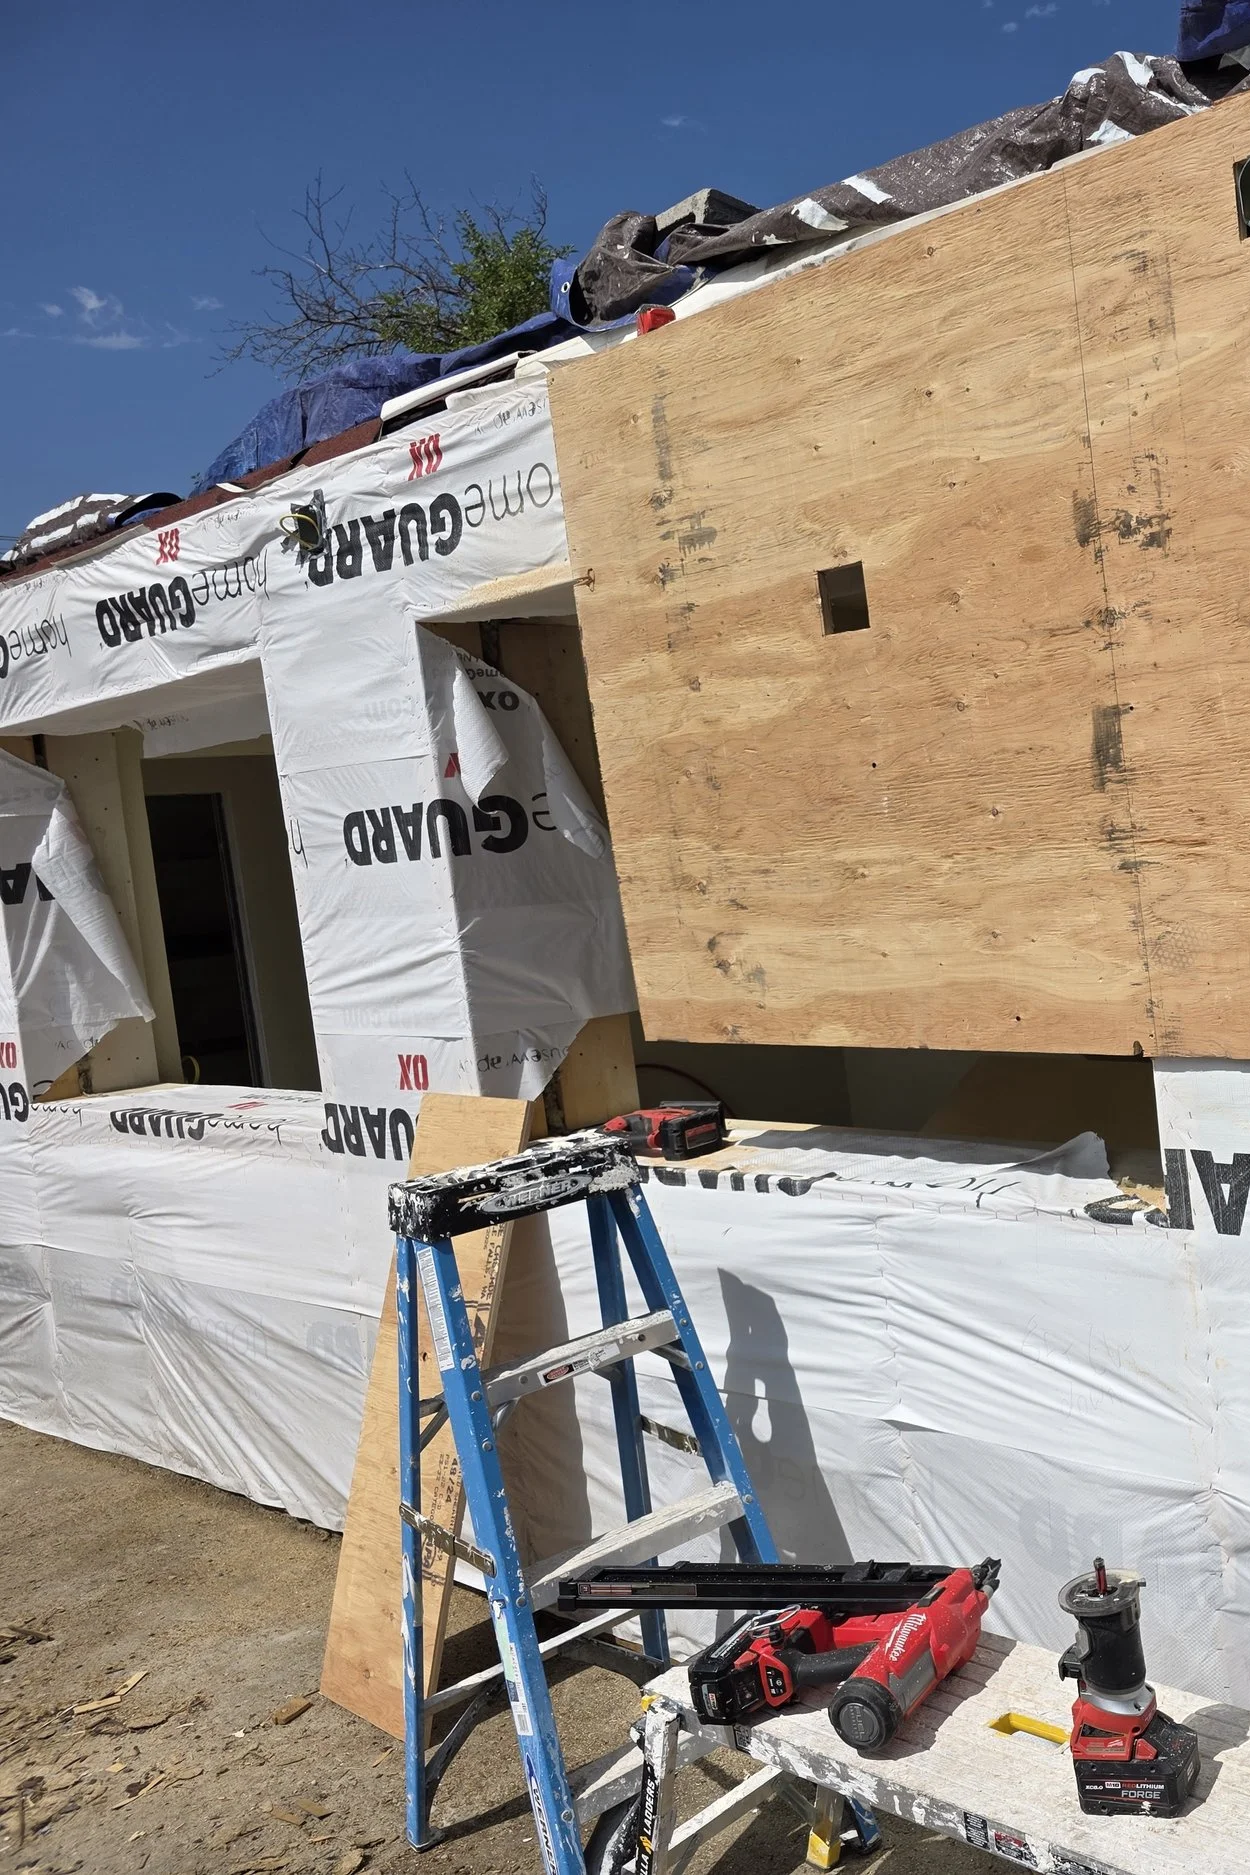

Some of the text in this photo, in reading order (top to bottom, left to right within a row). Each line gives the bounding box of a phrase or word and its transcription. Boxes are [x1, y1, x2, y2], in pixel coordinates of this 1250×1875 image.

[155, 528, 181, 565] OX
[309, 462, 553, 587] omeGUARD
[96, 549, 270, 648] homeGUARD
[344, 792, 558, 867] eGUARD
[398, 1053, 429, 1091] OX
[503, 1181, 572, 1207] WERNER
[429, 1486, 439, 1521] CATEGO
[445, 1457, 458, 1504] 48/24
[888, 1612, 927, 1662] Milwaukee
[643, 1779, 656, 1835] LADDERS
[1121, 1790, 1161, 1799] FORGE
[533, 1788, 558, 1875] WERNER
